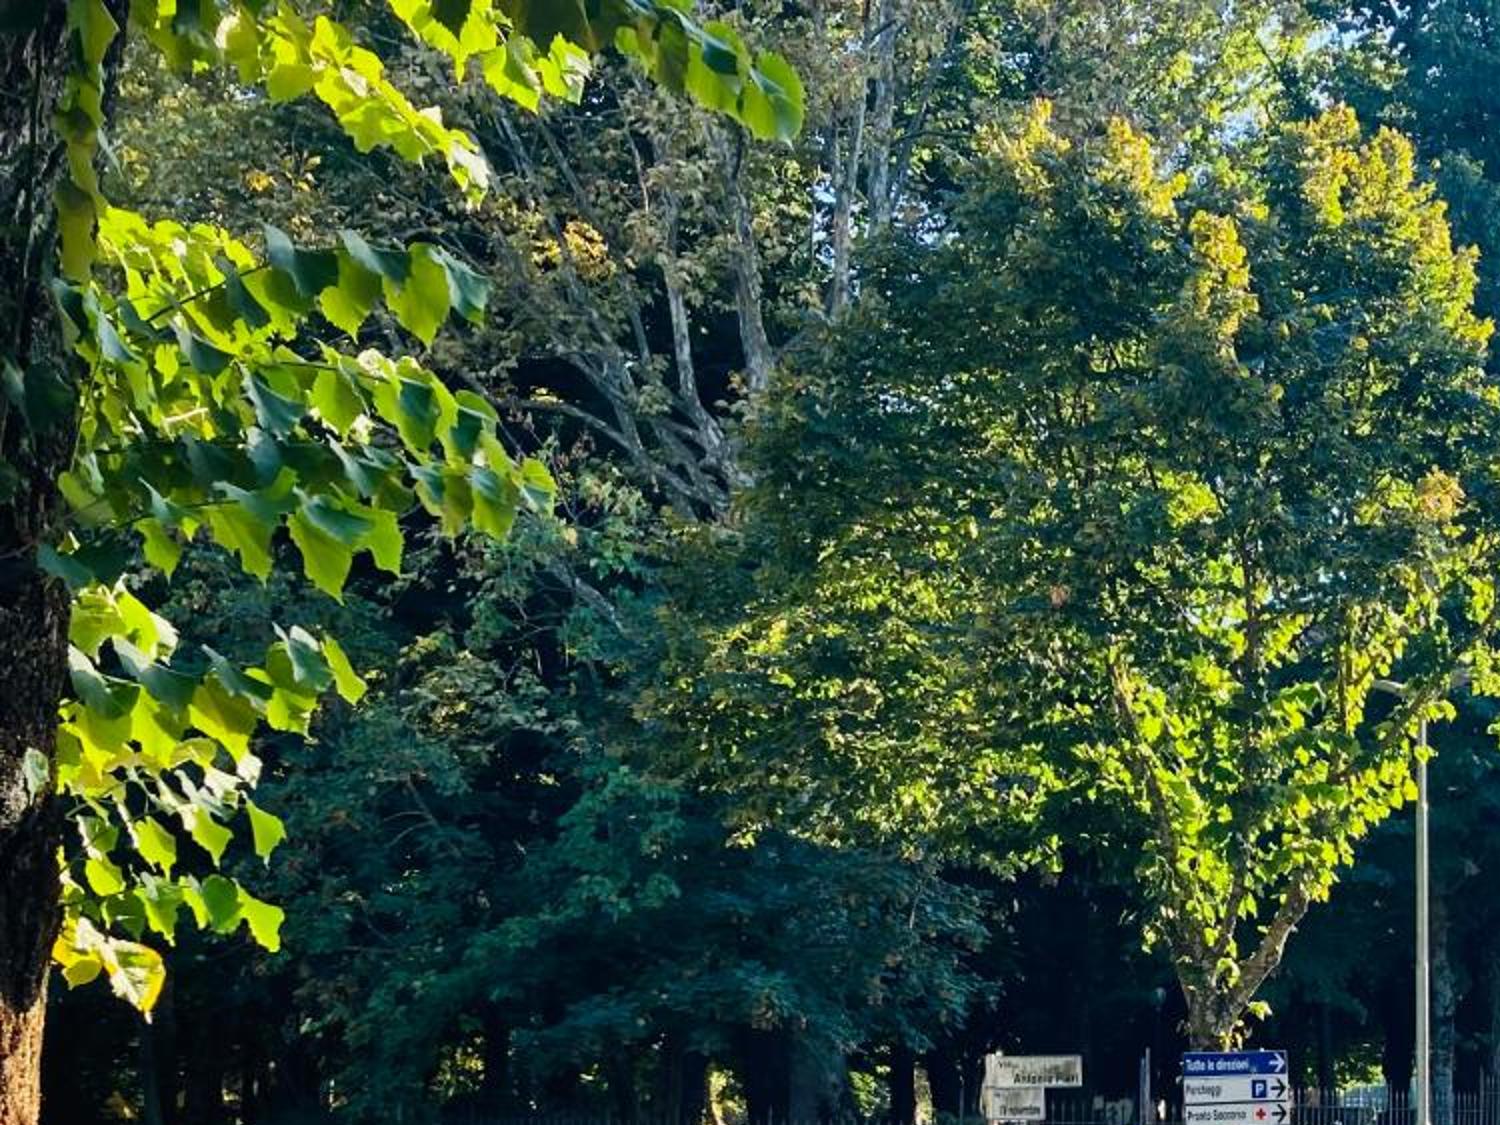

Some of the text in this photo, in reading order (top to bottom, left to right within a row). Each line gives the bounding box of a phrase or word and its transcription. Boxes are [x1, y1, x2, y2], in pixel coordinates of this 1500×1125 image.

[1186, 1060, 1205, 1071] Tutte
[1216, 1058, 1249, 1071] direzioni
[1186, 1084, 1221, 1097] Parcheggi
[1255, 1083, 1264, 1096] P
[1187, 1110, 1247, 1121] Pronto Soccorso
